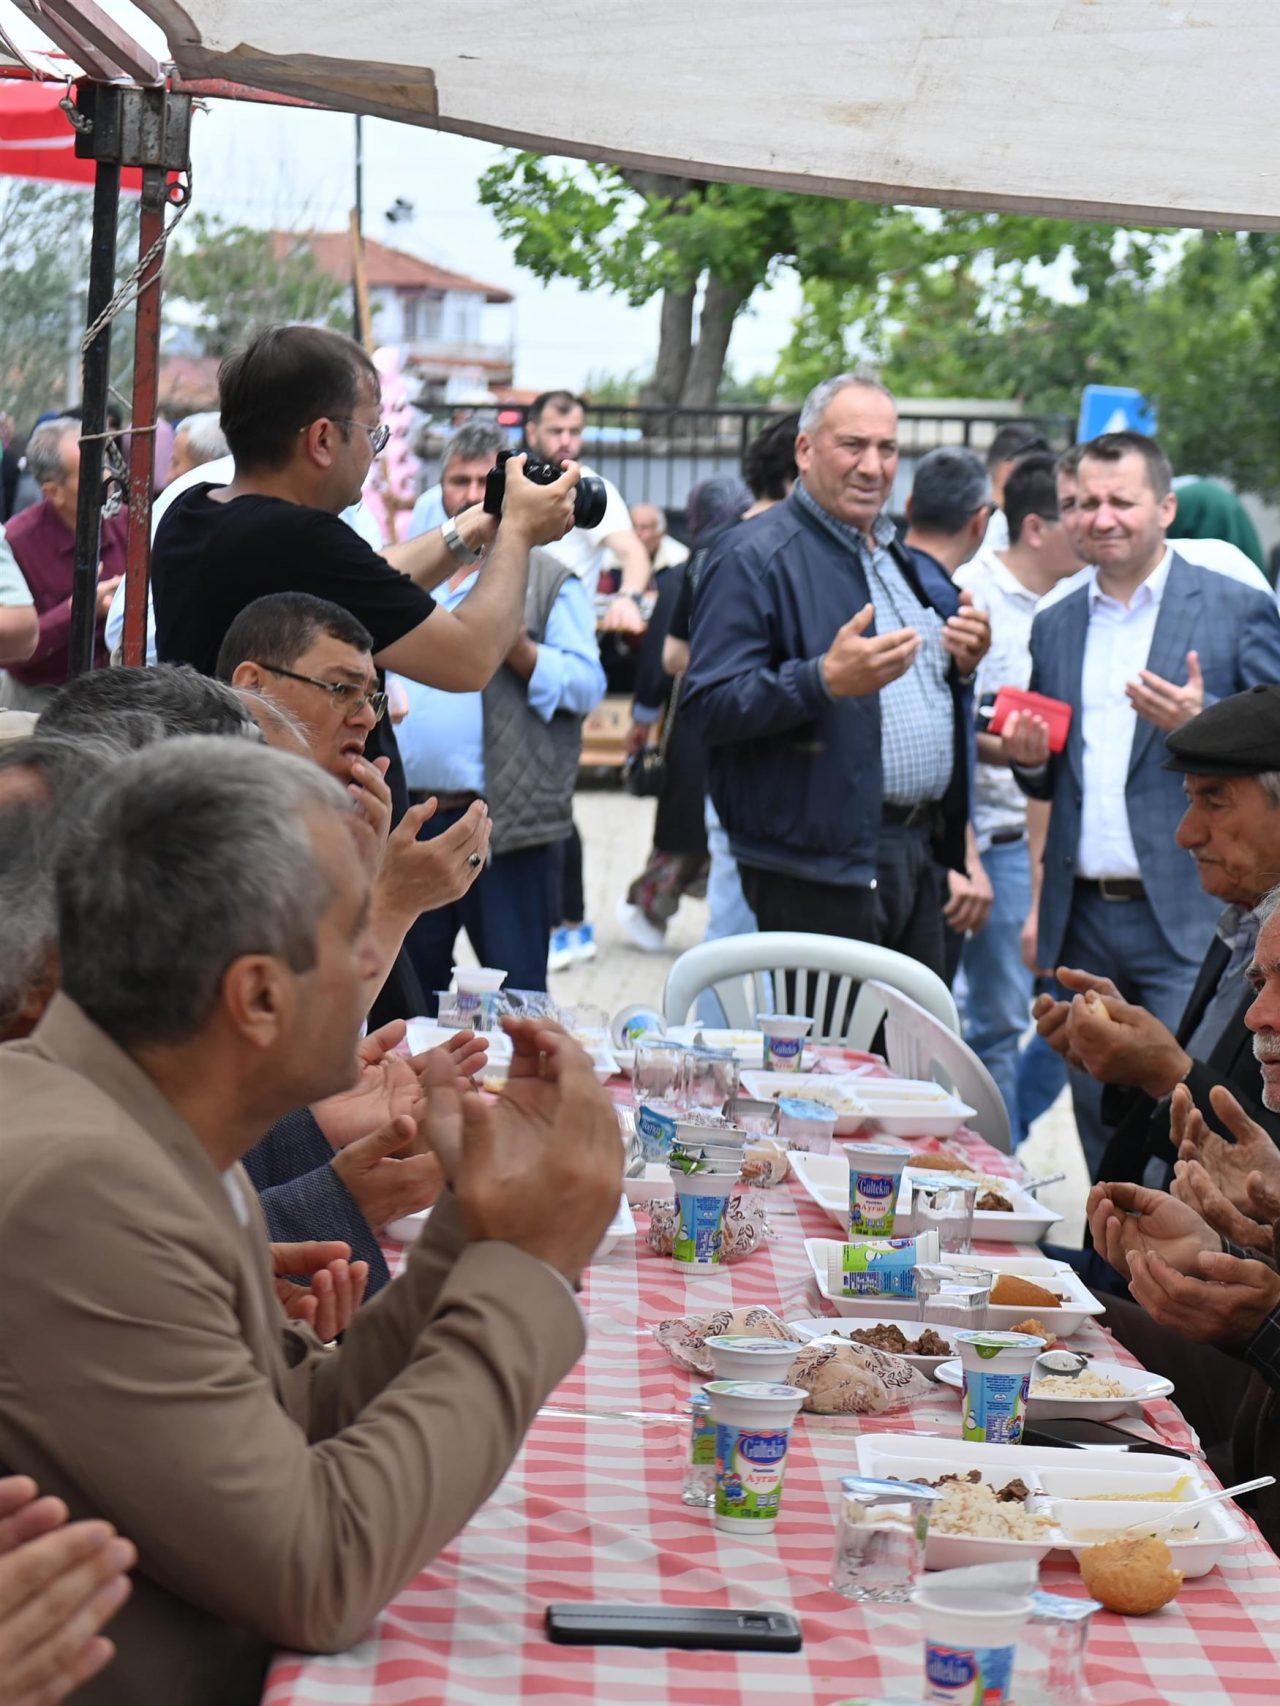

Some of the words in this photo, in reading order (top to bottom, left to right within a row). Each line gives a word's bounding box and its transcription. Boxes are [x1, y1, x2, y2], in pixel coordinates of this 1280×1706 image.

[860, 1179, 890, 1196] Gültekin
[861, 1204, 886, 1213] Ayran
[743, 1437, 785, 1458] Gültekin
[746, 1474, 778, 1485] Ayran
